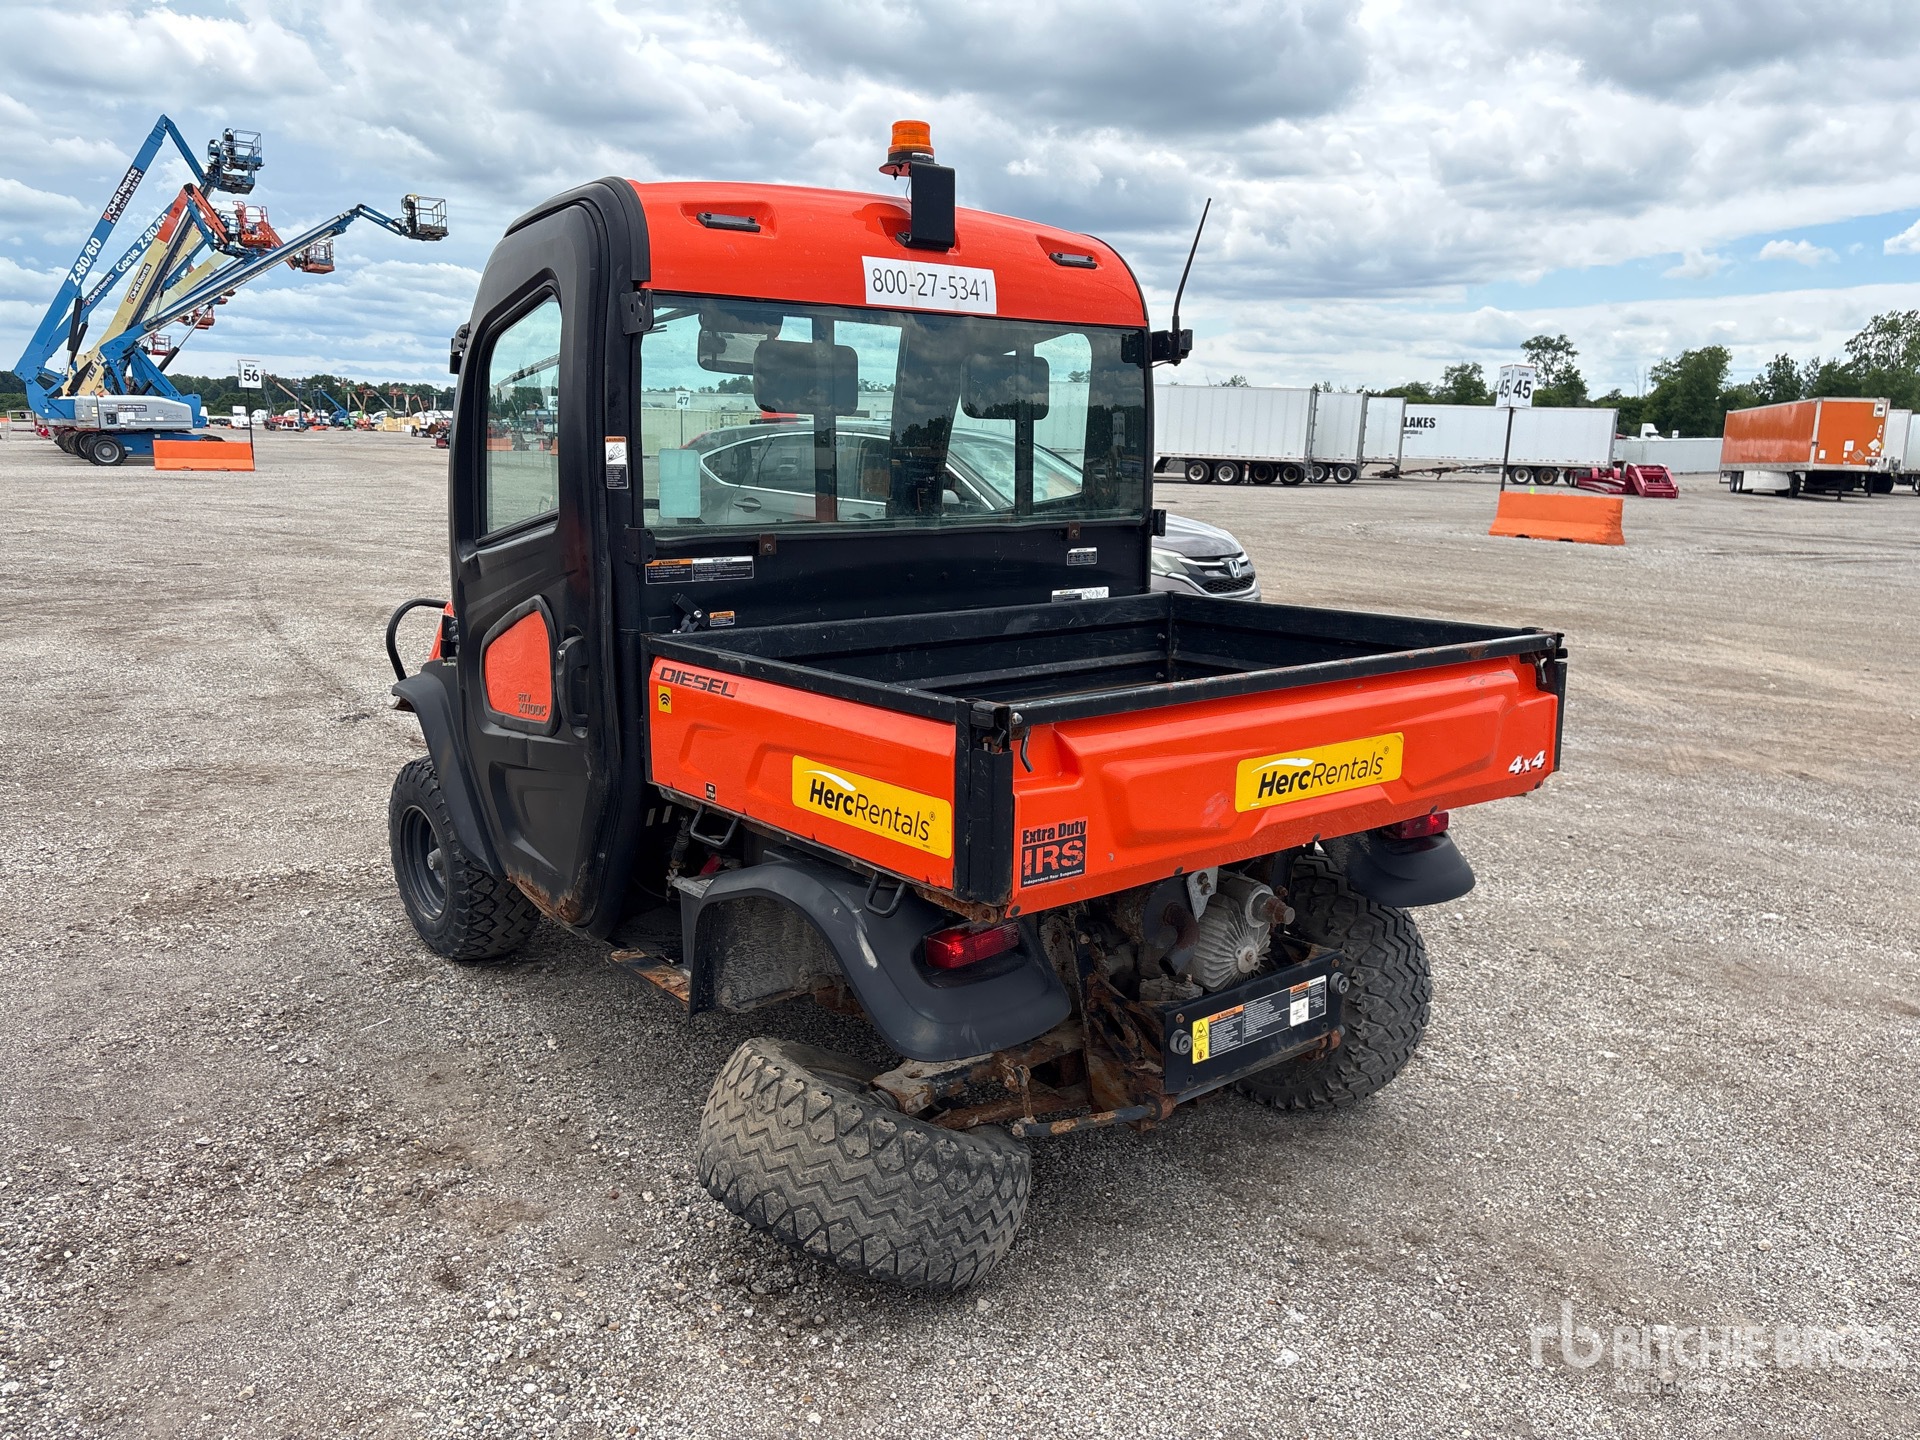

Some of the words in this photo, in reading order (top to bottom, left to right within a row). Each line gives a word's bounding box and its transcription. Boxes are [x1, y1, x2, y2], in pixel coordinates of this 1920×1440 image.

[107, 193, 123, 214] OHR
[118, 168, 138, 195] Rents
[68, 237, 102, 286] Z-80/60
[115, 248, 140, 272] Genie
[872, 268, 989, 302] 800-27-5341
[243, 369, 260, 382] 56
[677, 396, 689, 405] 47
[1499, 379, 1511, 398] 45
[1513, 380, 1531, 399] 45
[1404, 416, 1436, 429] LAKES
[660, 667, 735, 699] DIESEL
[1508, 750, 1546, 775] 4x4
[1023, 827, 1055, 846] Extra
[1058, 821, 1087, 838] Duty
[1024, 840, 1084, 876] IRS
